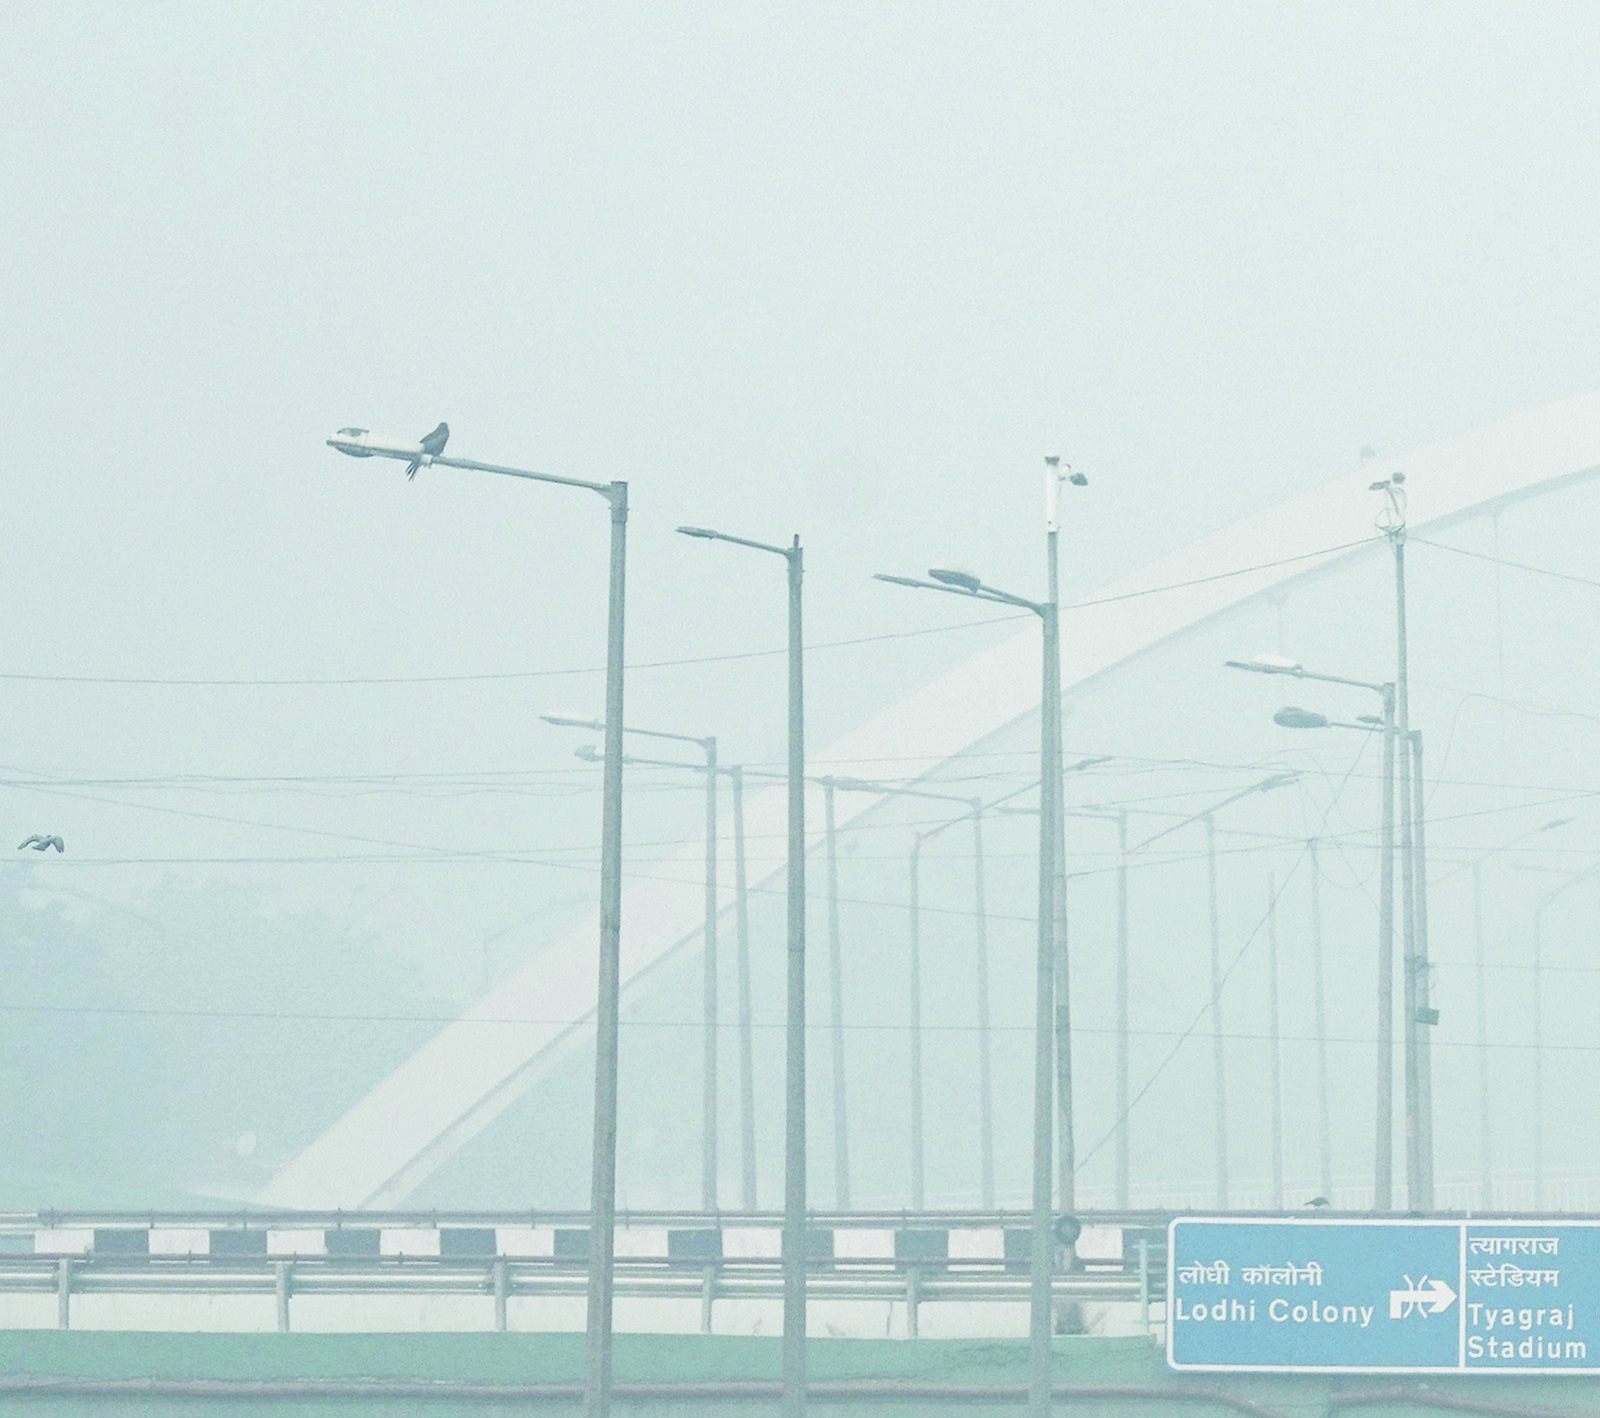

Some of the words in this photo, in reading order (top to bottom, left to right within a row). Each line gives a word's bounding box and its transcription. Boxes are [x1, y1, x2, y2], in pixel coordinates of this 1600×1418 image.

[1468, 1237, 1560, 1255] त्यागराज
[1177, 1260, 1230, 1285] लोधी
[1241, 1261, 1323, 1286] कॉलोनी
[1468, 1262, 1560, 1287] स्टेडियम
[1176, 1298, 1255, 1321] Lodhi
[1269, 1298, 1374, 1328] Colony
[1468, 1303, 1574, 1330] Tyagraj
[1468, 1336, 1586, 1359] Stadium
